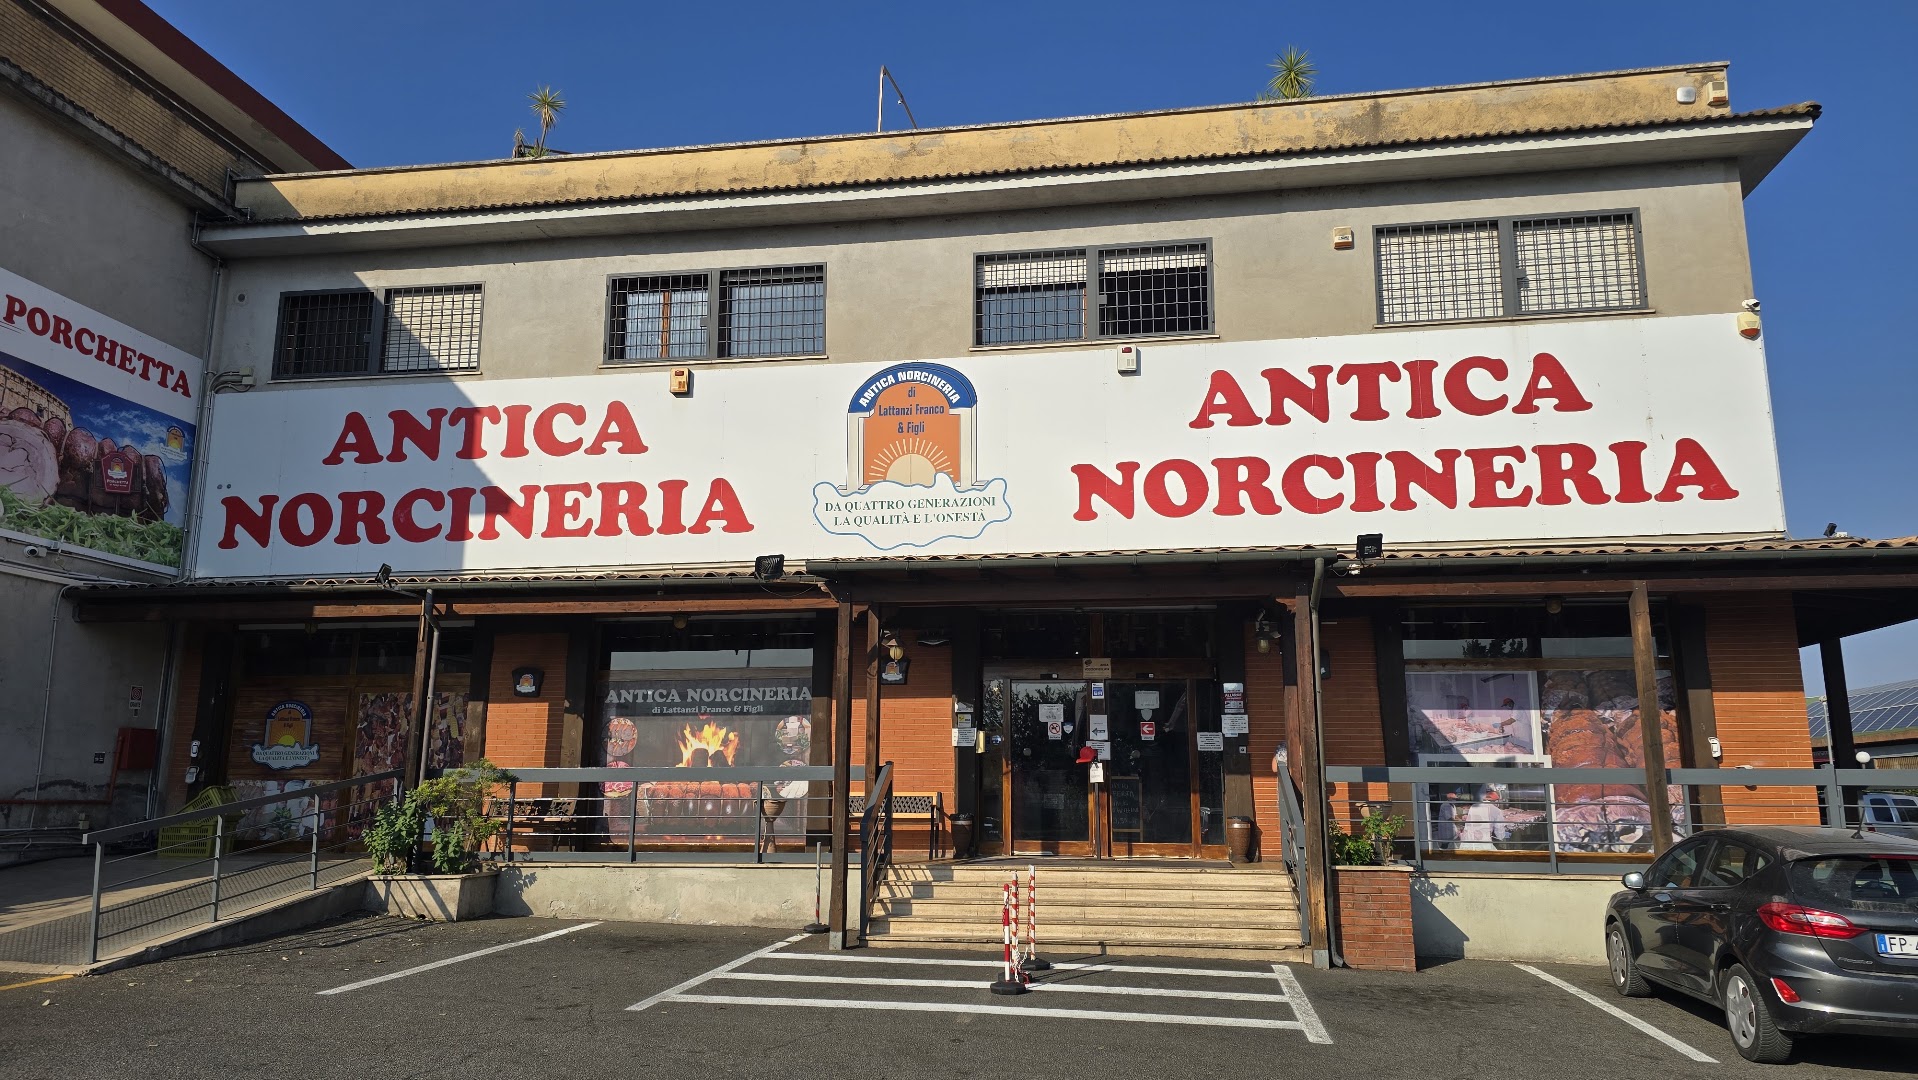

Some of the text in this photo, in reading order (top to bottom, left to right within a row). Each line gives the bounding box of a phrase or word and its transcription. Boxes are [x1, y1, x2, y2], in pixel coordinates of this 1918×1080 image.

[3, 294, 191, 398] PORCHETTA
[859, 371, 960, 407] ANTICA NORCINERIA
[908, 387, 916, 398] di
[1189, 353, 1593, 429] ANTICA
[878, 404, 945, 416] Lattanzi Franco
[322, 401, 649, 466] ANTICA
[897, 421, 925, 435] & Figli
[1071, 438, 1739, 521] NORCINERIA
[825, 496, 996, 513] DA QUATTRO GENERAZIONI
[217, 478, 754, 550] NORCINERIA
[834, 509, 986, 527] LA QUALITÀ E L'ONESTÀ
[605, 687, 812, 703] ANTICA NORCINERIA
[652, 704, 763, 714] di Lattanzi Franco & Figli
